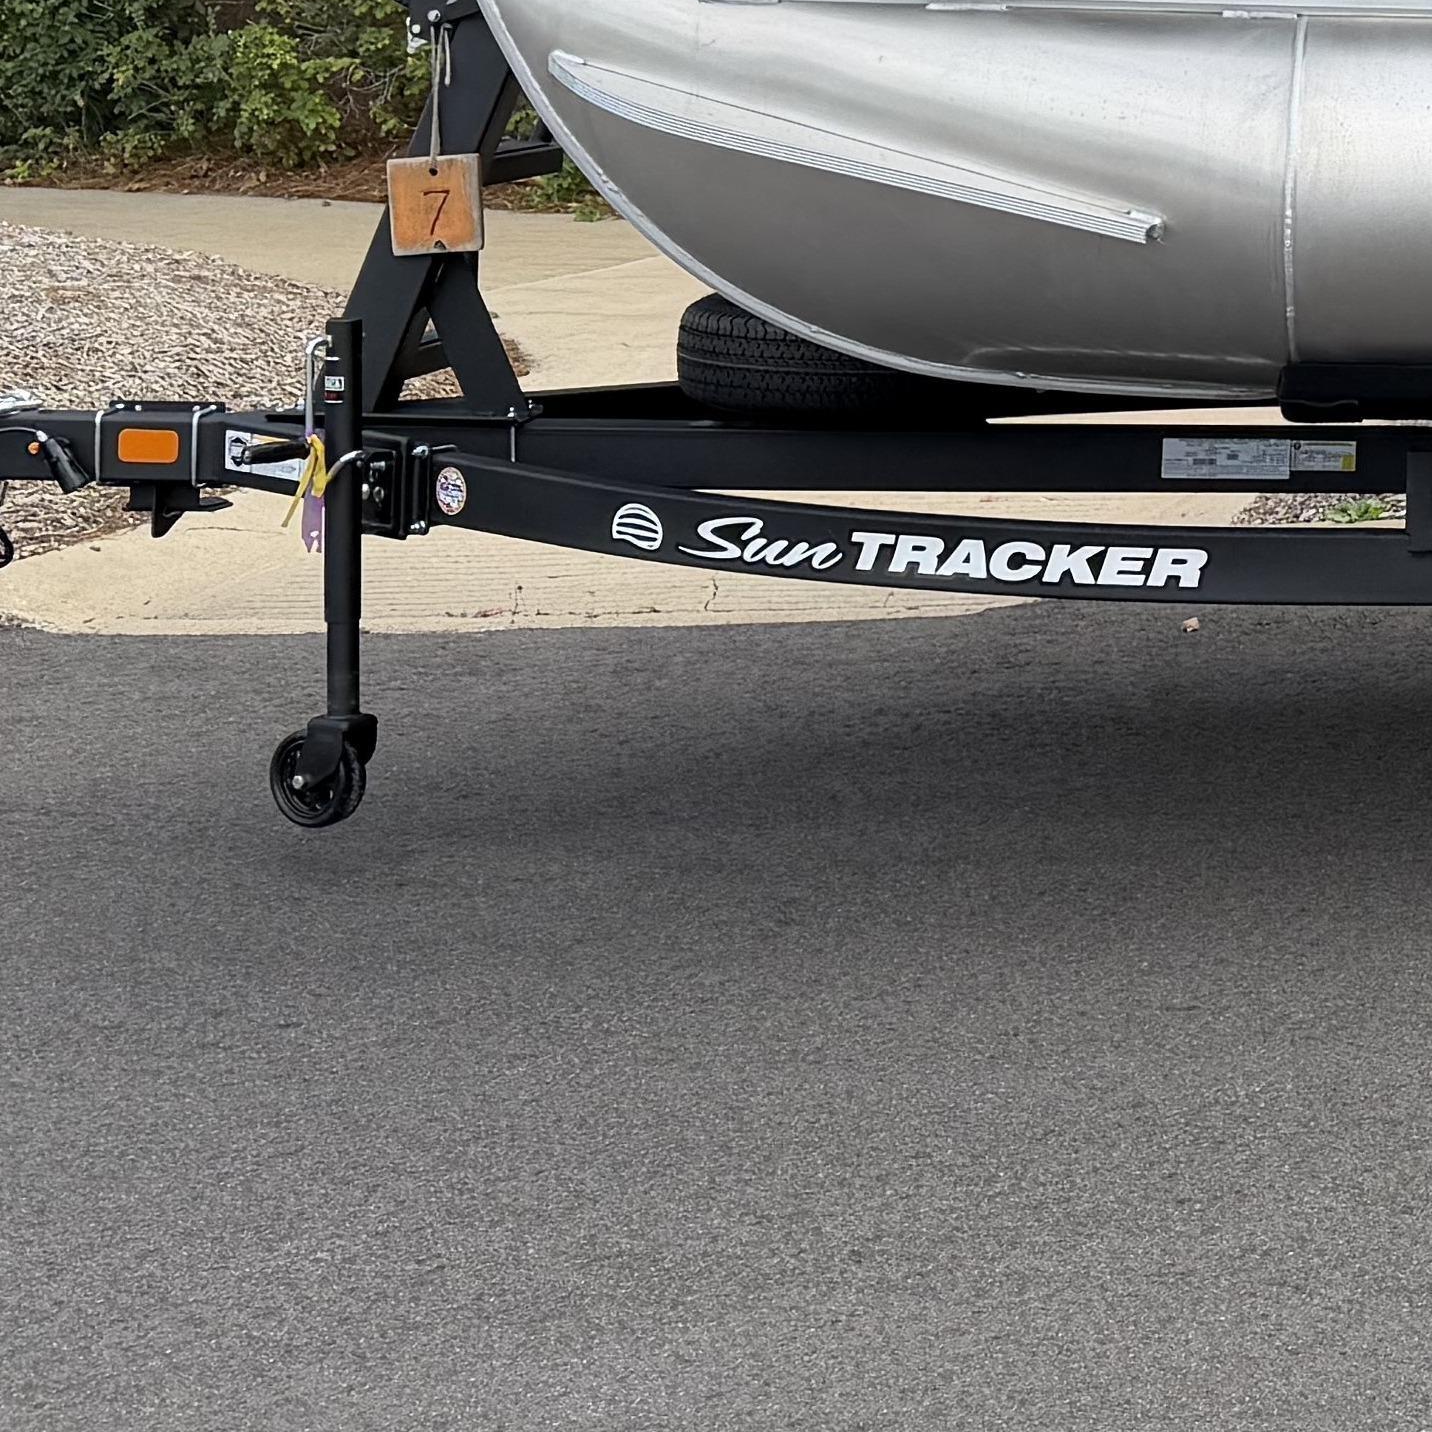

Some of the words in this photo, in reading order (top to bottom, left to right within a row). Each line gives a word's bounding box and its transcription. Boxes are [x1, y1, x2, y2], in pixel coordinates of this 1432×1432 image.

[422, 188, 451, 237] 7
[678, 516, 844, 571] Sun
[851, 531, 1208, 588] TRACKER
